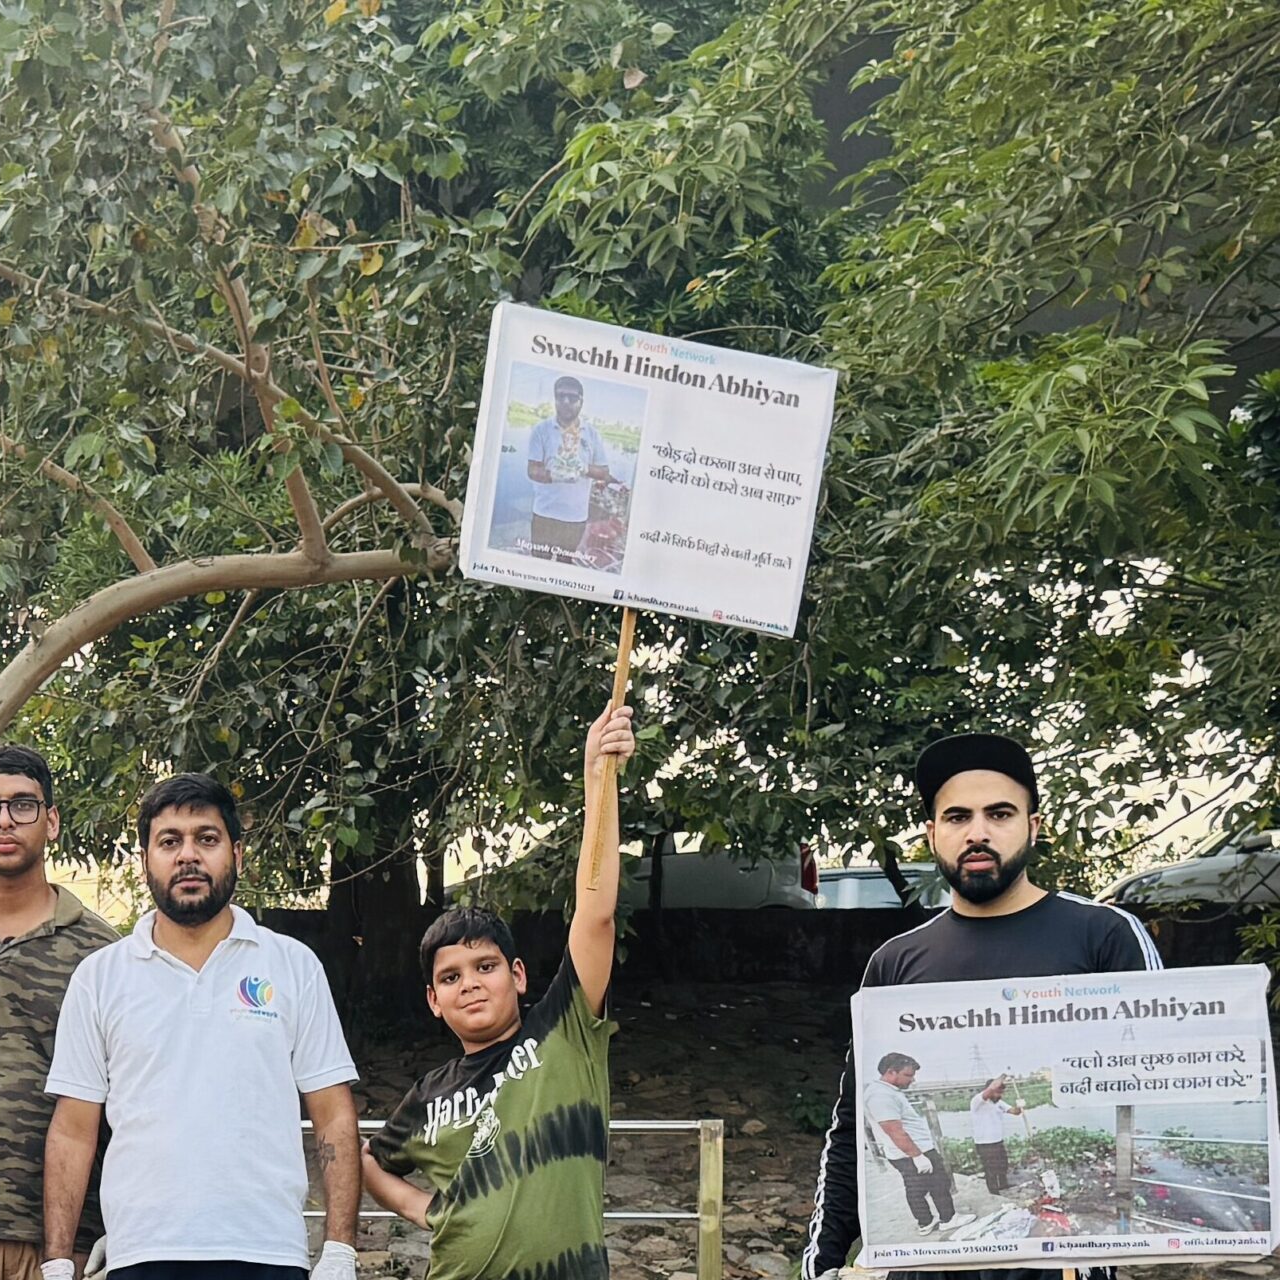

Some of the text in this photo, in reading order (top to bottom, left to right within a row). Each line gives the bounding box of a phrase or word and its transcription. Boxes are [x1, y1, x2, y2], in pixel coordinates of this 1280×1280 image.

[635, 339, 717, 365] Youth Network
[531, 334, 800, 408] Swachh Hindon Abhiyan
[1023, 984, 1121, 1000] Youth Network
[899, 997, 1225, 1033] Swachh Hindon Abhiyan
[1107, 1054, 1136, 1068] अब
[1140, 1053, 1174, 1071] कुछ
[1177, 1051, 1212, 1064] नाम
[1060, 1077, 1092, 1094] नदी
[1095, 1074, 1141, 1093] बचाने
[1144, 1078, 1169, 1091] का
[1172, 1076, 1212, 1090] काम
[423, 1086, 491, 1146] Harry
[874, 1250, 892, 1259] Join
[894, 1249, 910, 1257] The
[912, 1248, 961, 1256] Movement
